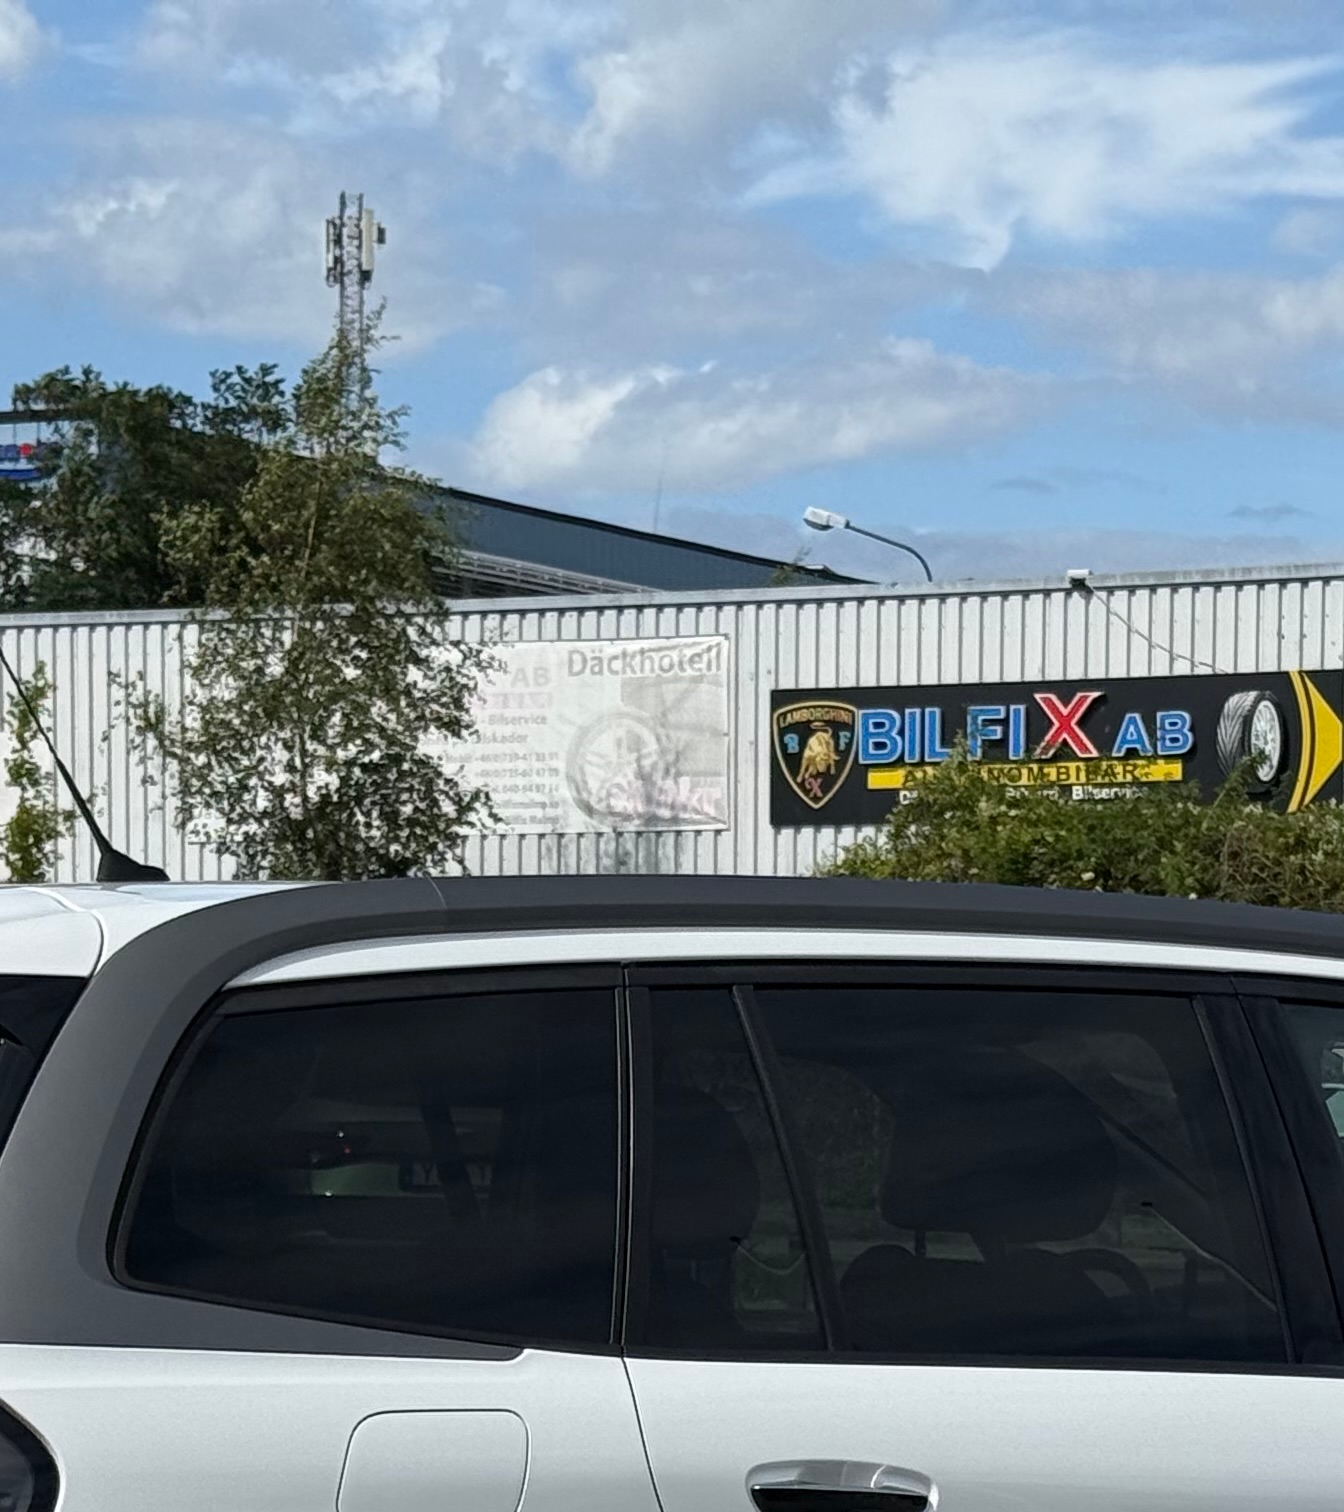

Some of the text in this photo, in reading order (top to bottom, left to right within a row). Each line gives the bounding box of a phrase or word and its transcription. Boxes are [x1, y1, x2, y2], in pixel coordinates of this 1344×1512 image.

[511, 667, 551, 688] AB
[779, 707, 853, 728] LAMBORGHINI
[838, 730, 852, 751] F
[1111, 711, 1194, 756] AB
